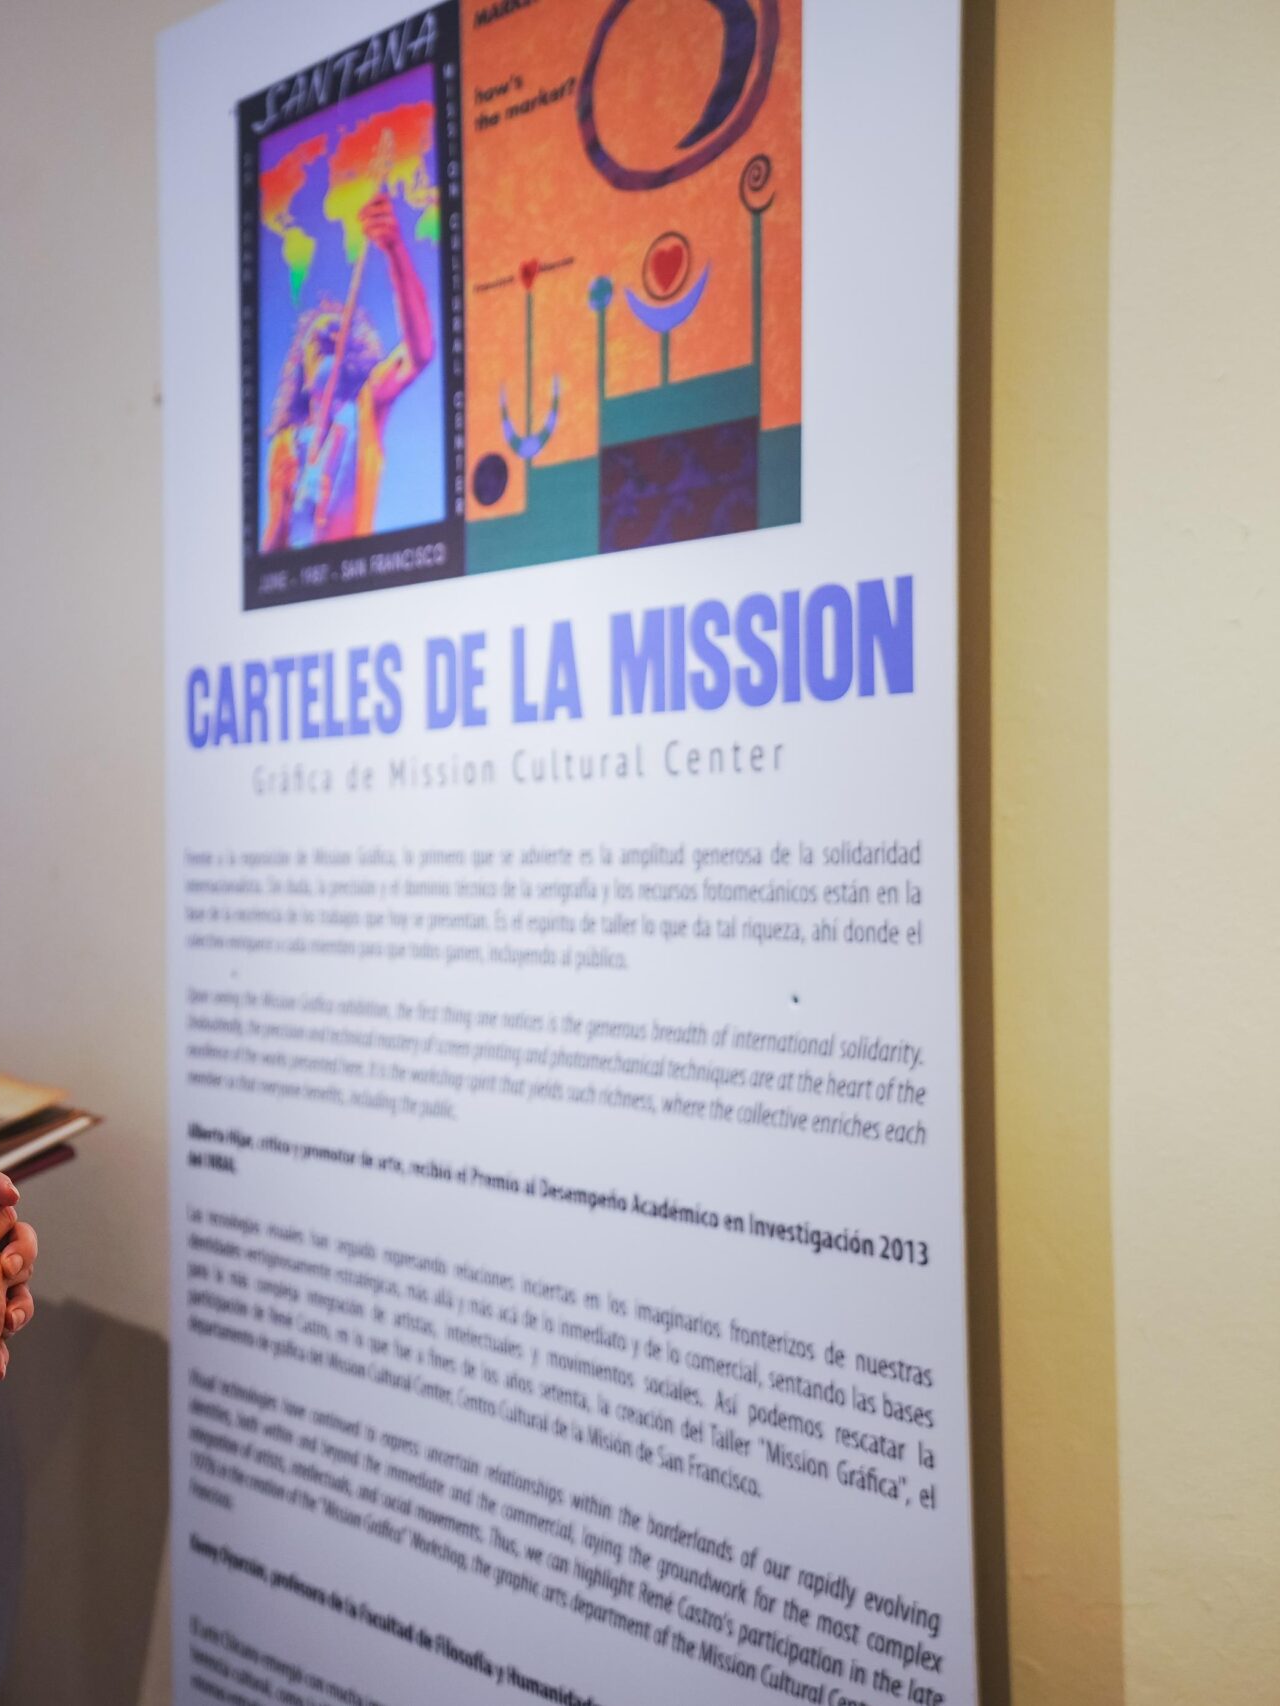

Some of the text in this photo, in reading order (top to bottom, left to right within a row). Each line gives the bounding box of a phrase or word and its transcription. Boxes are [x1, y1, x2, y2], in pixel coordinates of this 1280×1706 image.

[250, 14, 438, 134] SANTANA
[505, 76, 576, 119] market?
[371, 541, 447, 577] FRANCISCO
[187, 575, 915, 749] CARTELES DE LA MISSION
[251, 738, 786, 797] Gráfica de Mission Cultural Center
[620, 842, 684, 870] amplitud
[692, 848, 761, 870] generosa
[770, 841, 790, 864] de
[798, 841, 812, 864] la
[822, 840, 921, 864] solidaridad
[638, 883, 697, 900] recursos
[702, 878, 817, 903] fotomecánicos
[822, 882, 868, 905] están
[876, 887, 897, 905] en
[905, 882, 920, 906] la
[659, 919, 686, 941] que
[692, 914, 710, 937] da
[716, 915, 735, 938] tal
[741, 917, 804, 945] riqueza,
[811, 918, 836, 941] ahí
[843, 918, 898, 943] donde
[906, 920, 921, 944] el
[650, 1019, 706, 1045] breadth
[711, 1025, 728, 1047] of
[731, 1027, 833, 1057] international
[839, 1036, 923, 1071] solidarity.
[667, 1057, 745, 1088] techniques
[749, 1069, 773, 1088] are
[777, 1070, 794, 1090] at
[797, 1069, 821, 1093] the
[826, 1071, 872, 1099] heart
[875, 1077, 896, 1102] of
[896, 1079, 926, 1105] the
[661, 1091, 703, 1117] where
[708, 1096, 733, 1120] the
[736, 1101, 806, 1130] collective
[811, 1112, 878, 1140] enriches
[884, 1122, 926, 1147] each
[540, 1177, 626, 1211] Desempeño
[630, 1192, 717, 1227] Académico
[724, 1213, 743, 1232] en
[749, 1213, 873, 1256] Investigación
[879, 1236, 928, 1267] 2013
[636, 1298, 720, 1337] imaginarios
[730, 1318, 814, 1360] fronterizos
[824, 1340, 844, 1367] de
[854, 1353, 932, 1389] nuestras
[645, 1334, 660, 1358] de
[685, 1349, 762, 1388] comercial,
[768, 1370, 844, 1406] sentando
[851, 1385, 876, 1415] las
[882, 1394, 933, 1431] bases
[615, 1402, 672, 1433] creación
[681, 1415, 702, 1442] del
[711, 1425, 749, 1456] Taller
[918, 1486, 935, 1511] el
[645, 1376, 703, 1407] sociales.
[715, 1390, 736, 1416] Así
[747, 1402, 822, 1439] podemos
[834, 1426, 905, 1463] rescatar
[917, 1443, 934, 1471] la
[635, 1438, 652, 1464] de
[656, 1446, 682, 1473] San
[688, 1455, 762, 1497] Francisco.
[645, 1512, 732, 1562] borderlands
[739, 1547, 758, 1571] of
[762, 1557, 790, 1582] our
[797, 1568, 855, 1610] rapidly
[863, 1591, 941, 1641] evolving
[656, 1556, 746, 1603] groundwork
[753, 1584, 776, 1614] for
[783, 1597, 808, 1625] the
[816, 1613, 859, 1644] most
[866, 1631, 943, 1675] complex
[638, 1581, 671, 1611] René
[676, 1594, 732, 1634] Castro's
[737, 1621, 842, 1675] participation
[849, 1657, 866, 1684] in
[871, 1667, 901, 1697] the
[907, 1677, 944, 1706] late
[653, 1624, 671, 1648] of
[671, 1629, 694, 1656] the
[697, 1639, 755, 1679] Mission
[760, 1662, 822, 1705] Cultural
